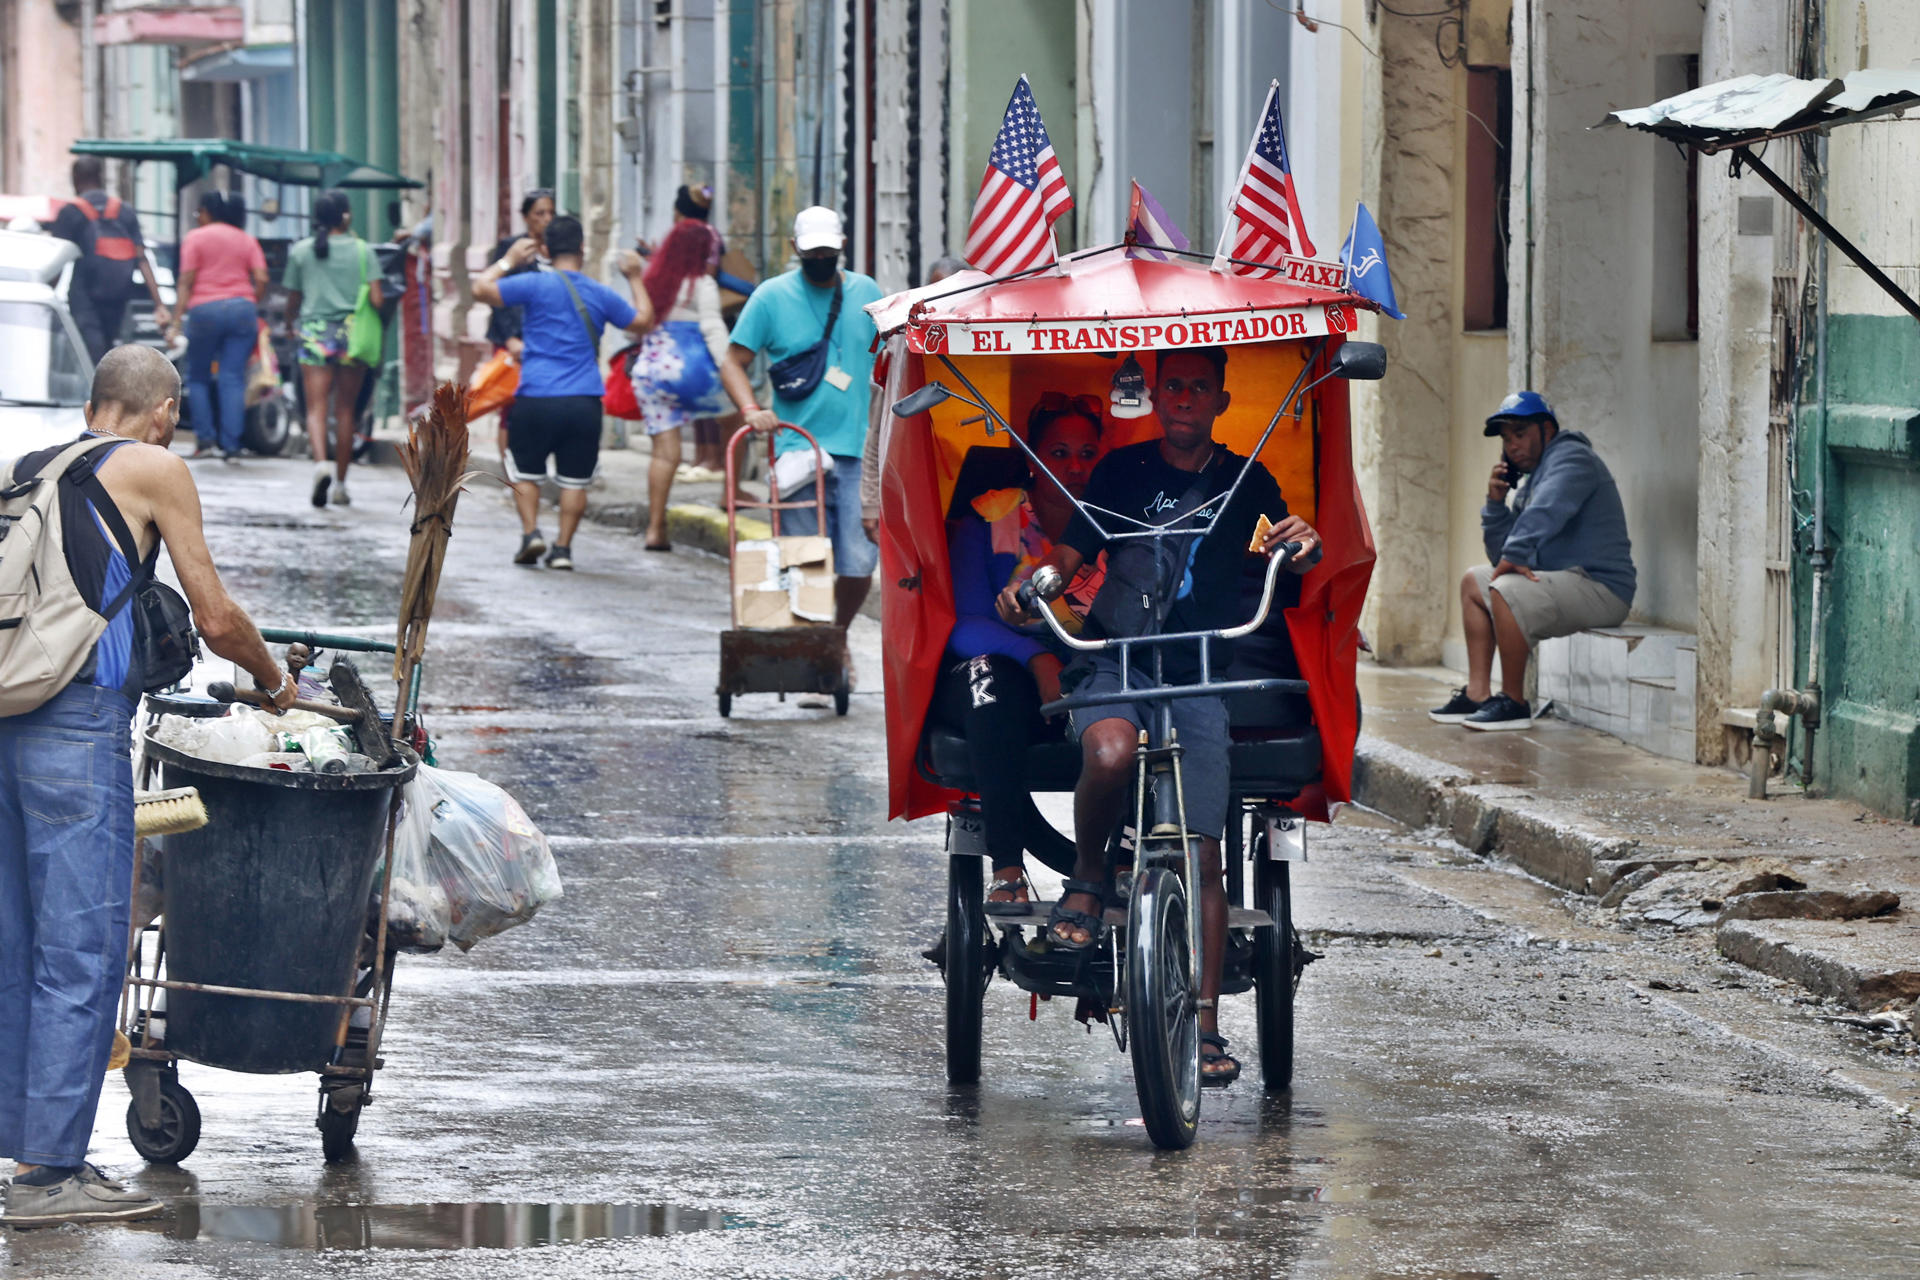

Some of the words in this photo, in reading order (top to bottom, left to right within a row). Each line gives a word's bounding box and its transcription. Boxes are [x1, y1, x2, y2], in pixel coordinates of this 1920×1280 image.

[1287, 261, 1344, 288] TAXI
[971, 330, 1011, 352] EL
[1027, 313, 1308, 351] TRANSPORTADOR
